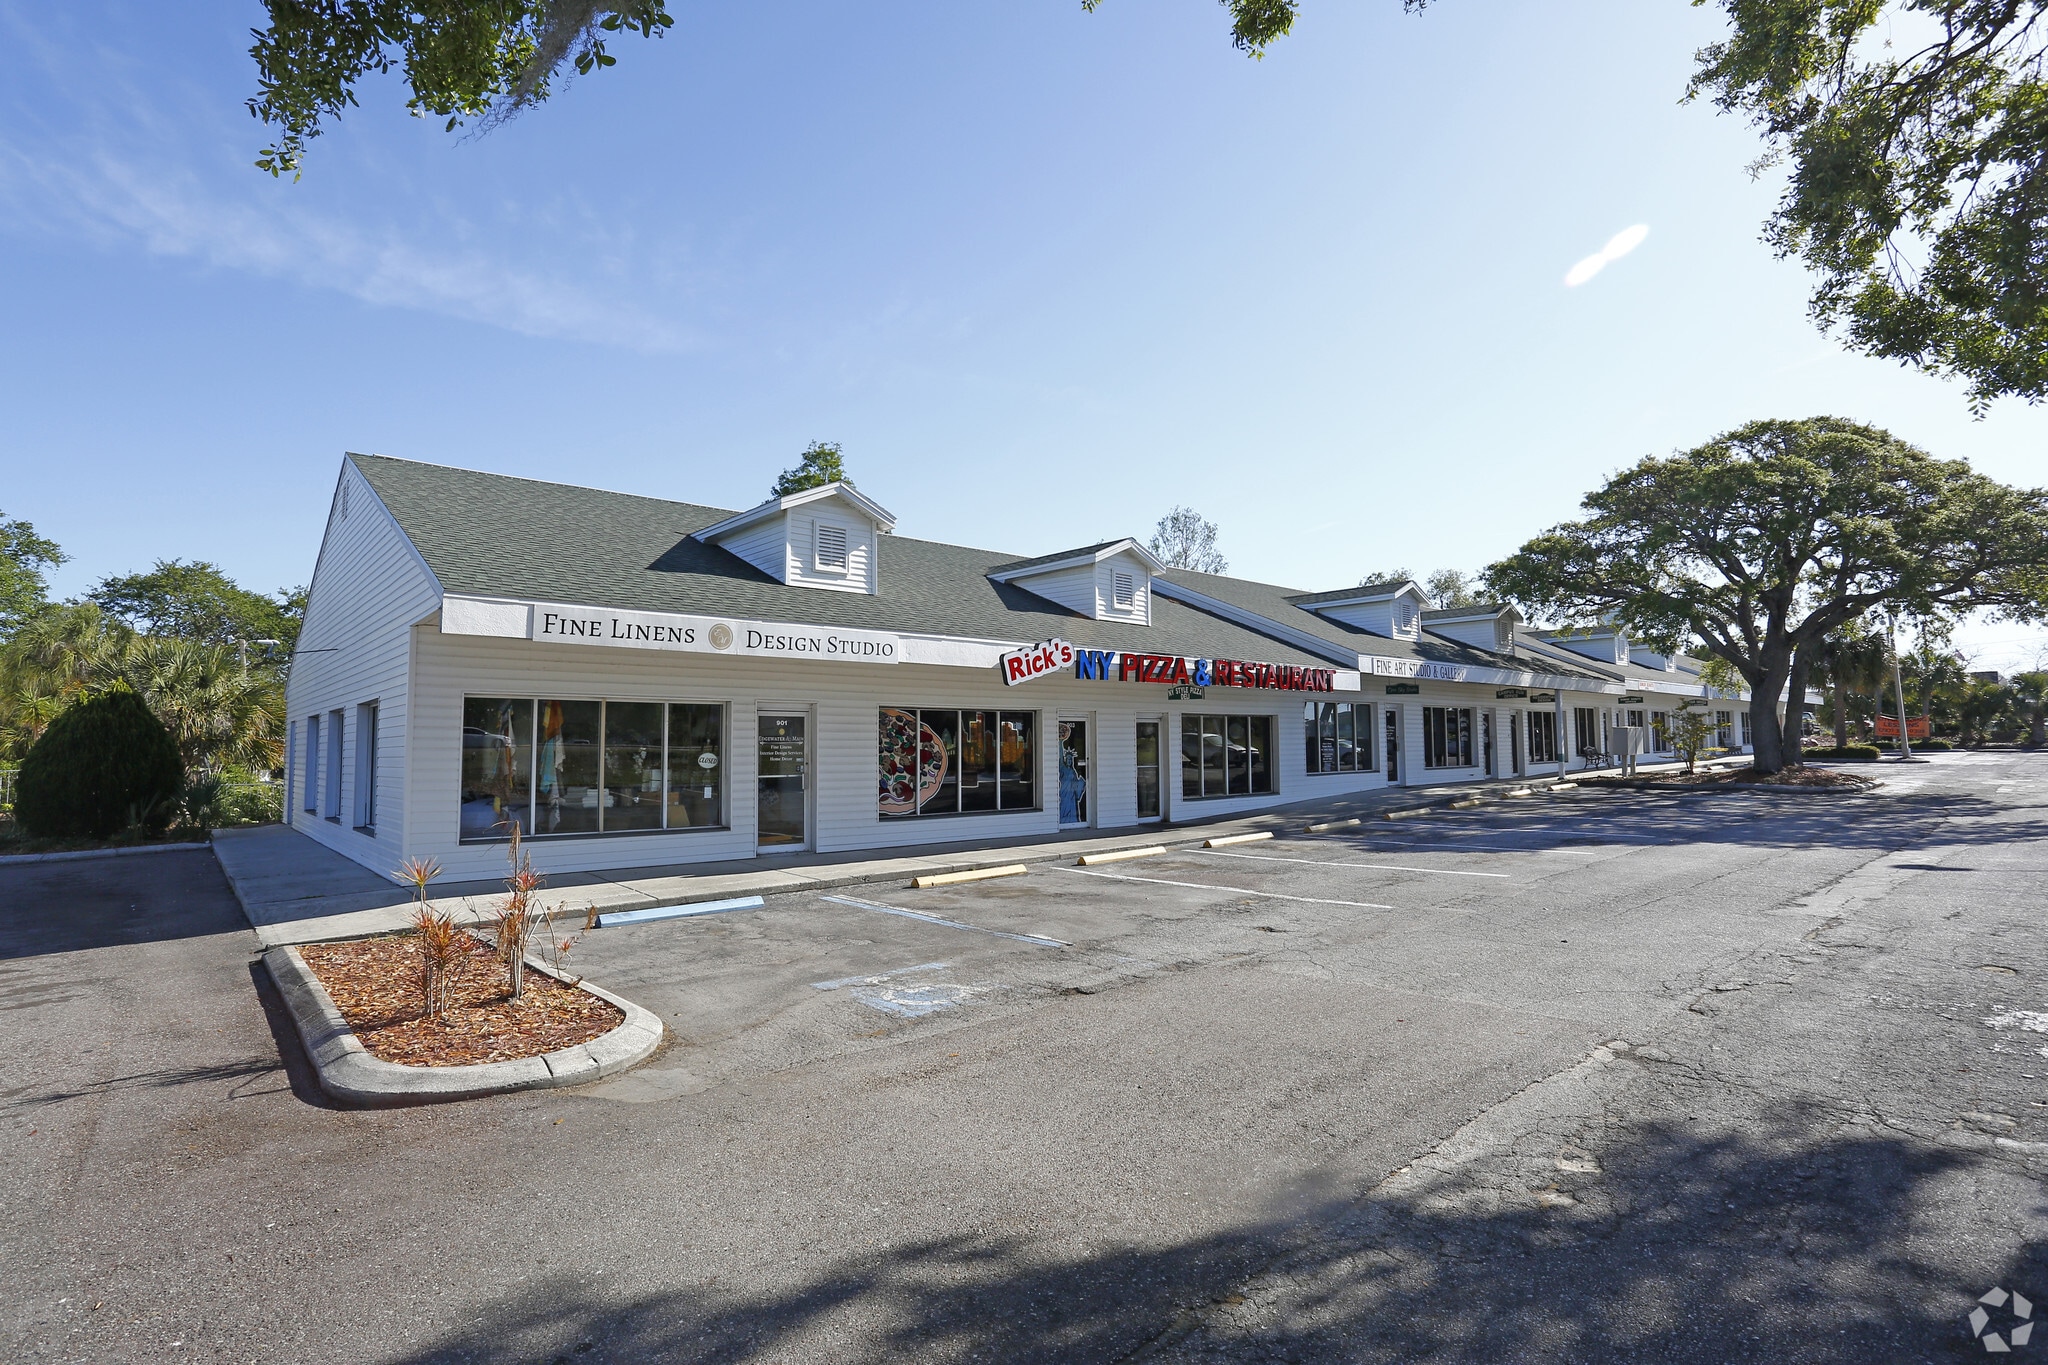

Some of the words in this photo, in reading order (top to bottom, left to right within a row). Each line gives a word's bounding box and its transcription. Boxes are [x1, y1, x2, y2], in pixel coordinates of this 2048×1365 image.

[542, 613, 602, 637] FINE
[611, 619, 695, 643] LINENS
[746, 630, 821, 652] DESIGN
[827, 636, 893, 656] STUDIO
[1007, 642, 1072, 682] Rick's
[1077, 650, 1115, 680] NY
[1120, 653, 1189, 684] PIZZA
[1193, 658, 1211, 686] &
[1213, 659, 1336, 692] RESTAURANT
[1376, 660, 1392, 674] FINE
[1394, 661, 1407, 675] ART
[1409, 663, 1431, 677] STUDIO
[1433, 665, 1439, 679] &
